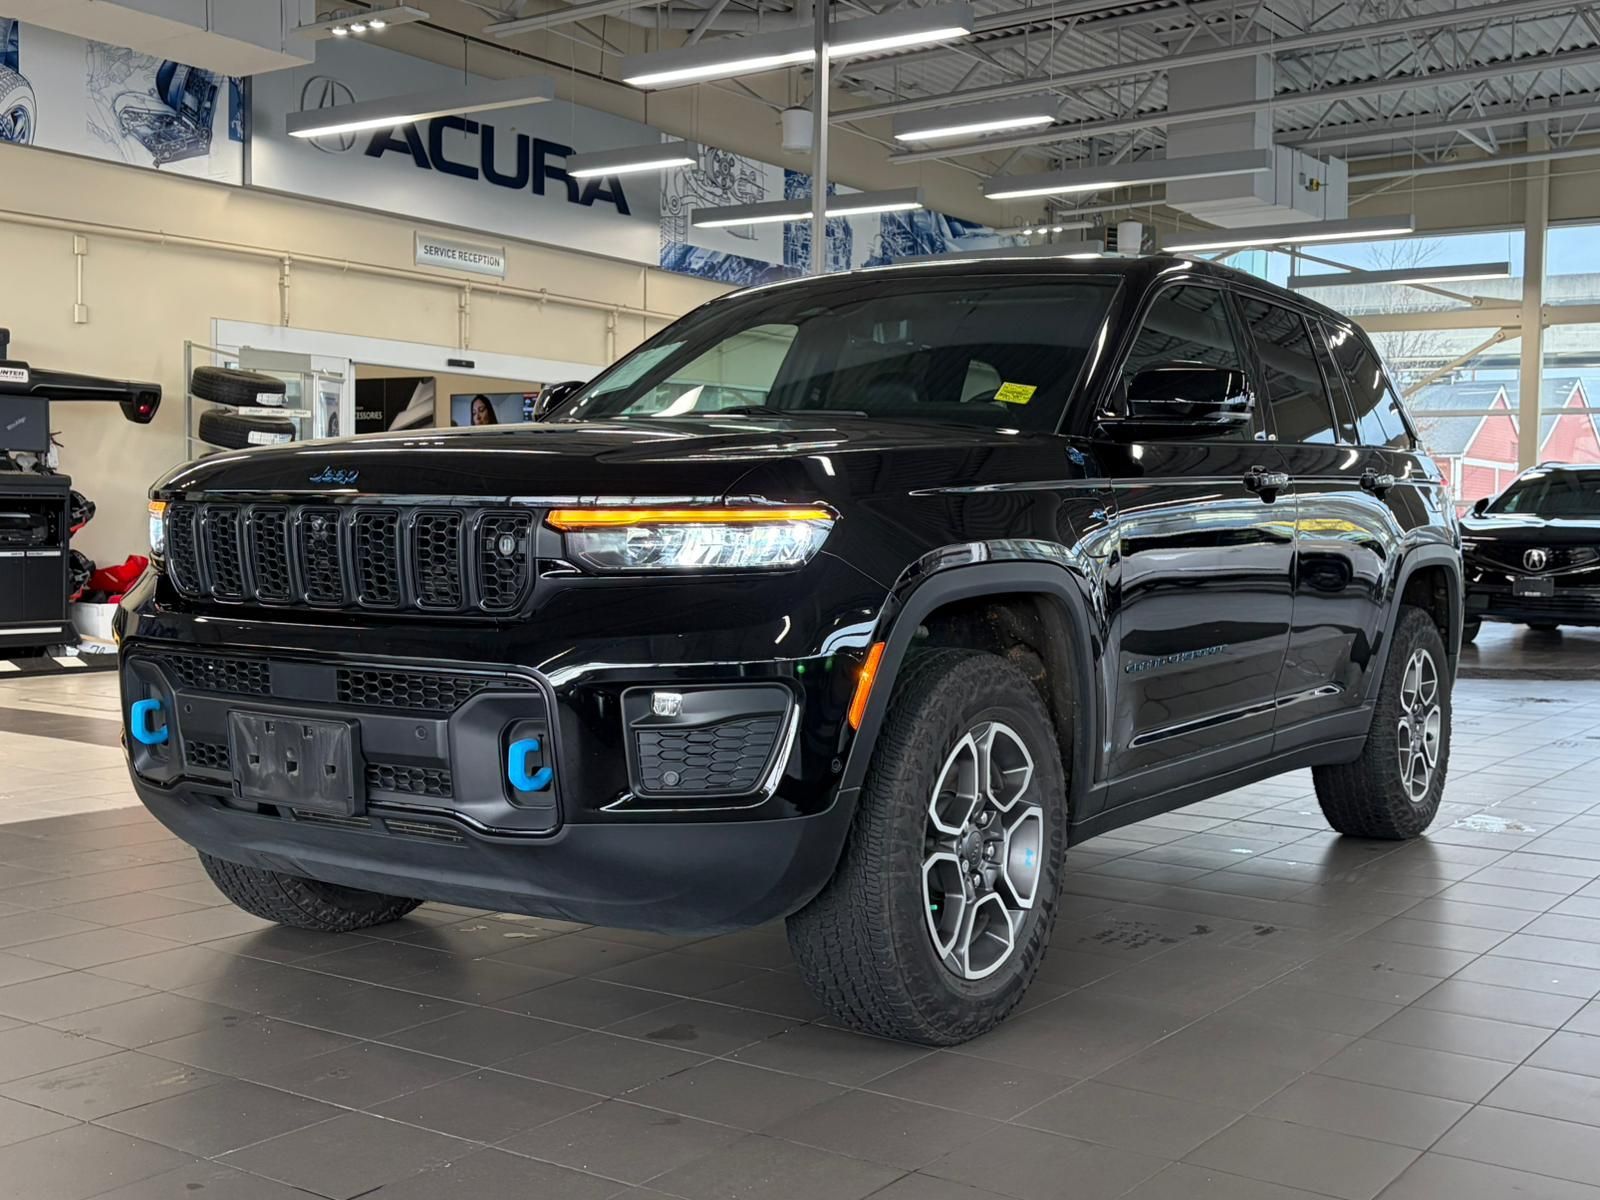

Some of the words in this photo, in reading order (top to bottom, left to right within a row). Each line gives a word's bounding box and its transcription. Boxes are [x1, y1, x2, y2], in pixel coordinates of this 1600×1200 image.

[364, 113, 631, 216] ACURA
[423, 245, 457, 259] SERVICE
[458, 250, 500, 267] RECEPTION
[309, 466, 359, 485] Jeep
